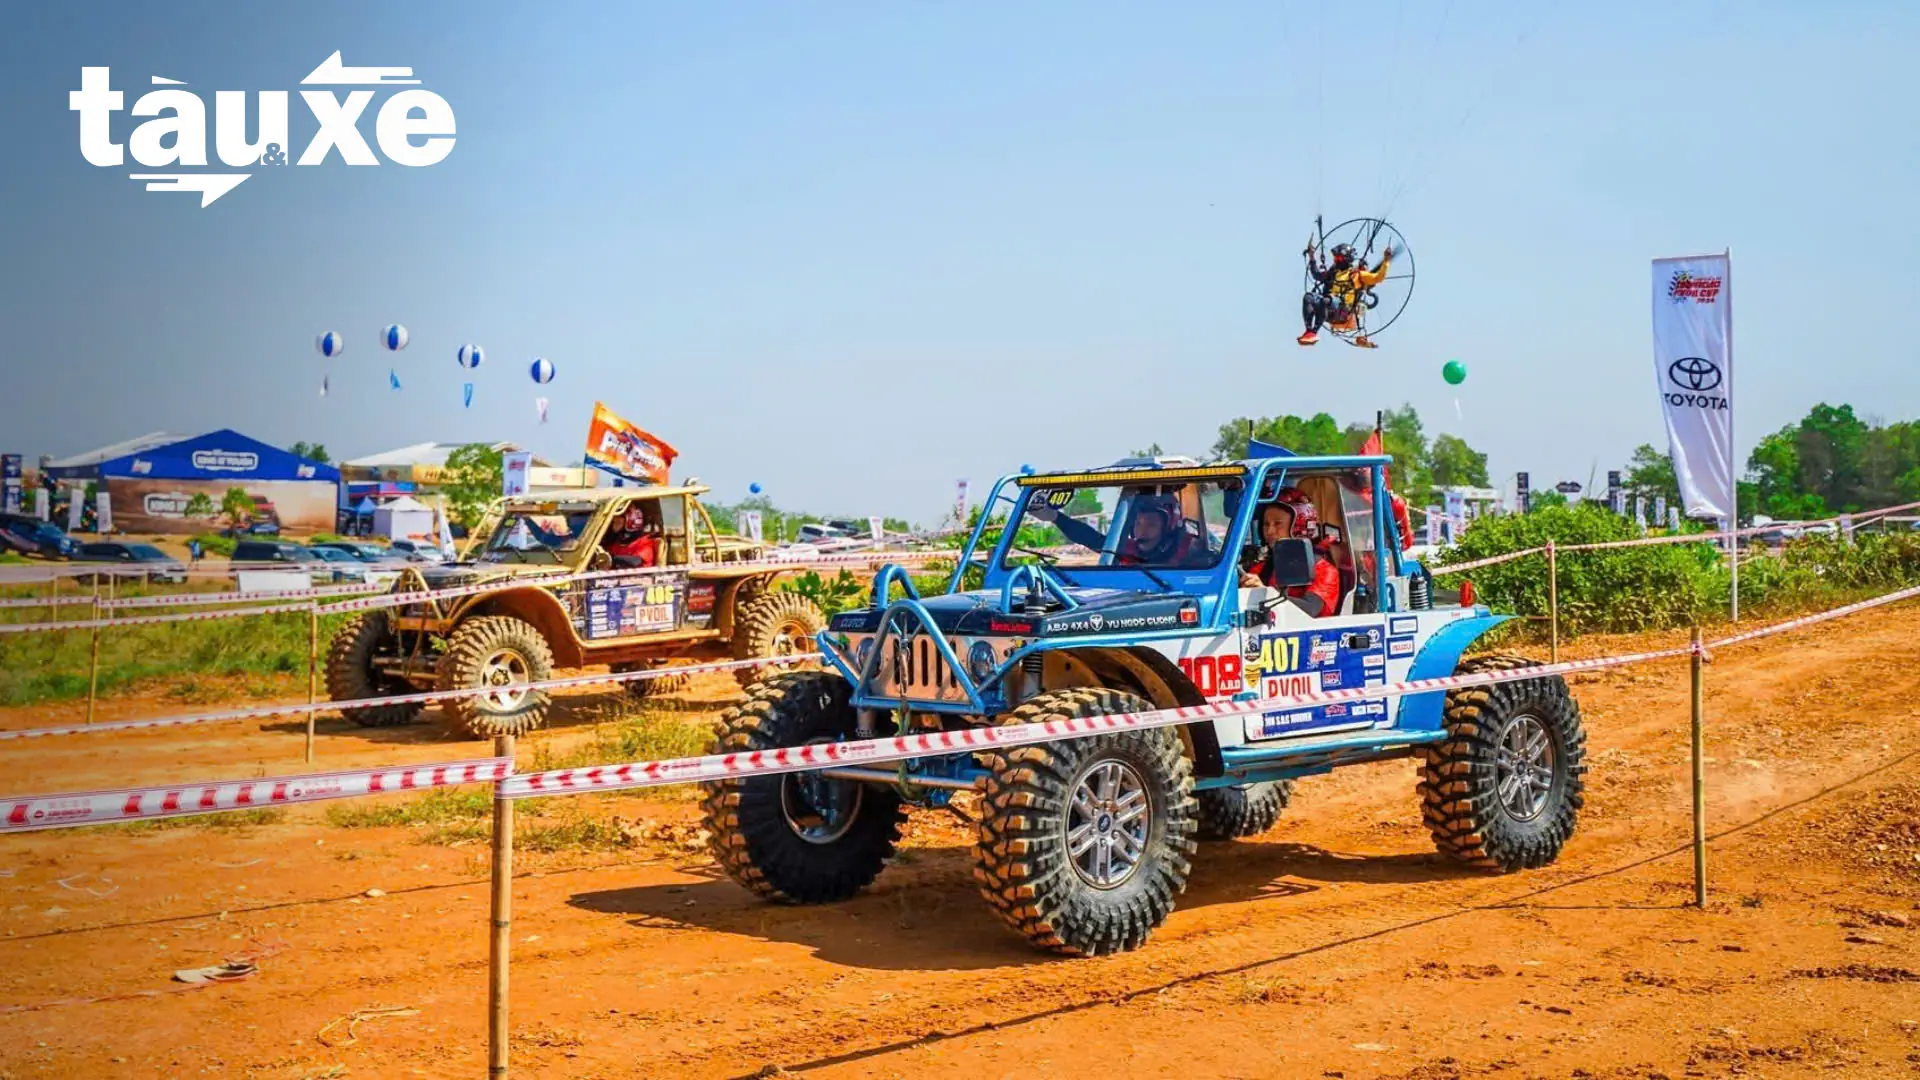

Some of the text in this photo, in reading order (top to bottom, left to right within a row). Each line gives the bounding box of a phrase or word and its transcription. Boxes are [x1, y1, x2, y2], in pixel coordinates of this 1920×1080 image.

[1664, 391, 1729, 411] TOYOTA
[1049, 491, 1072, 506] 407
[640, 606, 669, 622] PVOIL
[1258, 636, 1300, 673] 407
